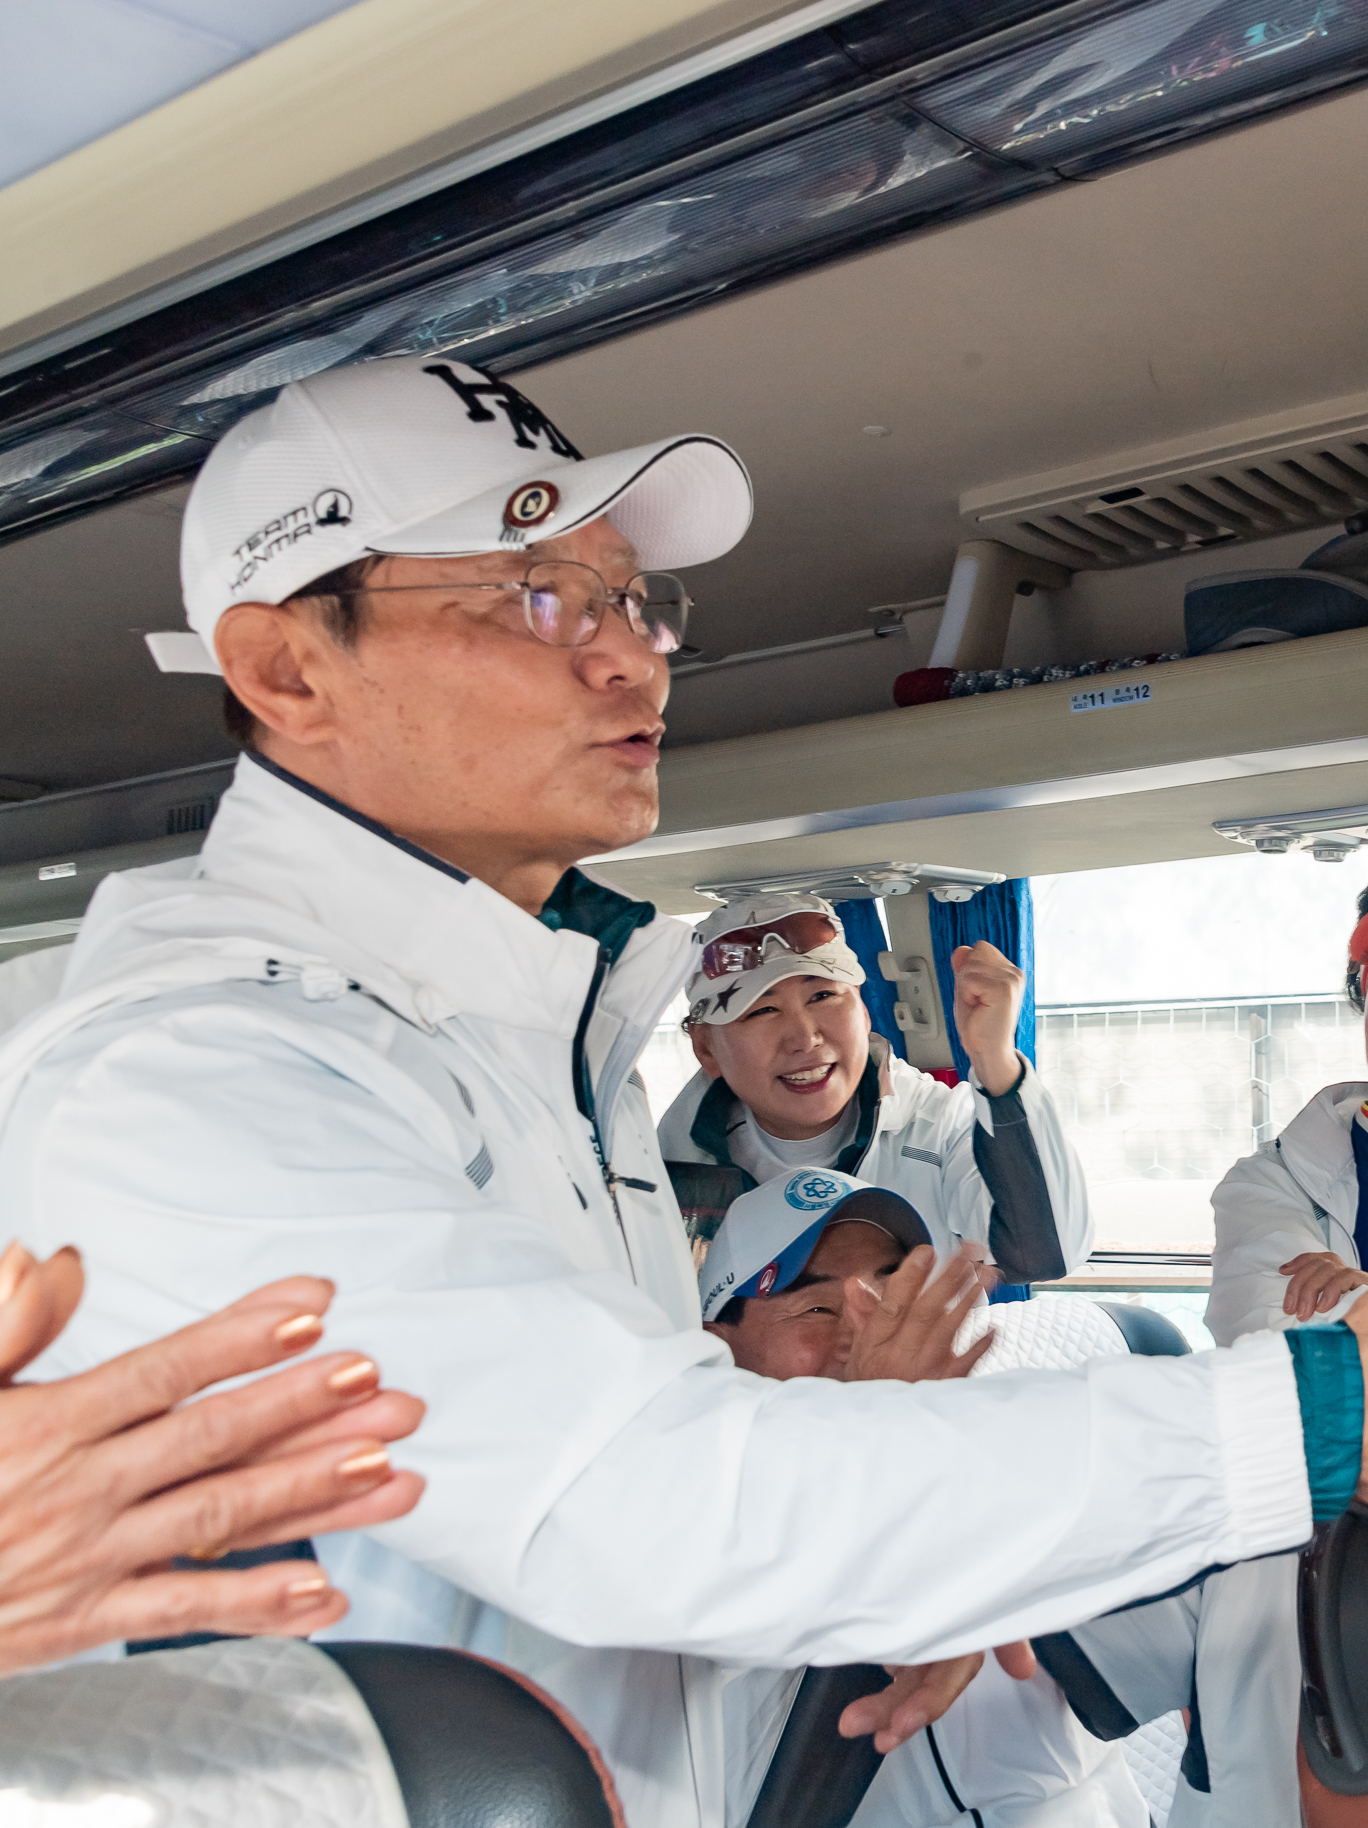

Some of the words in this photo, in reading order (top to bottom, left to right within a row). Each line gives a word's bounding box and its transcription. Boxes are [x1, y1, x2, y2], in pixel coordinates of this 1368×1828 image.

[229, 523, 313, 597] HONMA
[233, 506, 309, 561] TEAM
[1089, 691, 1105, 706] 11
[1134, 684, 1150, 699] 12
